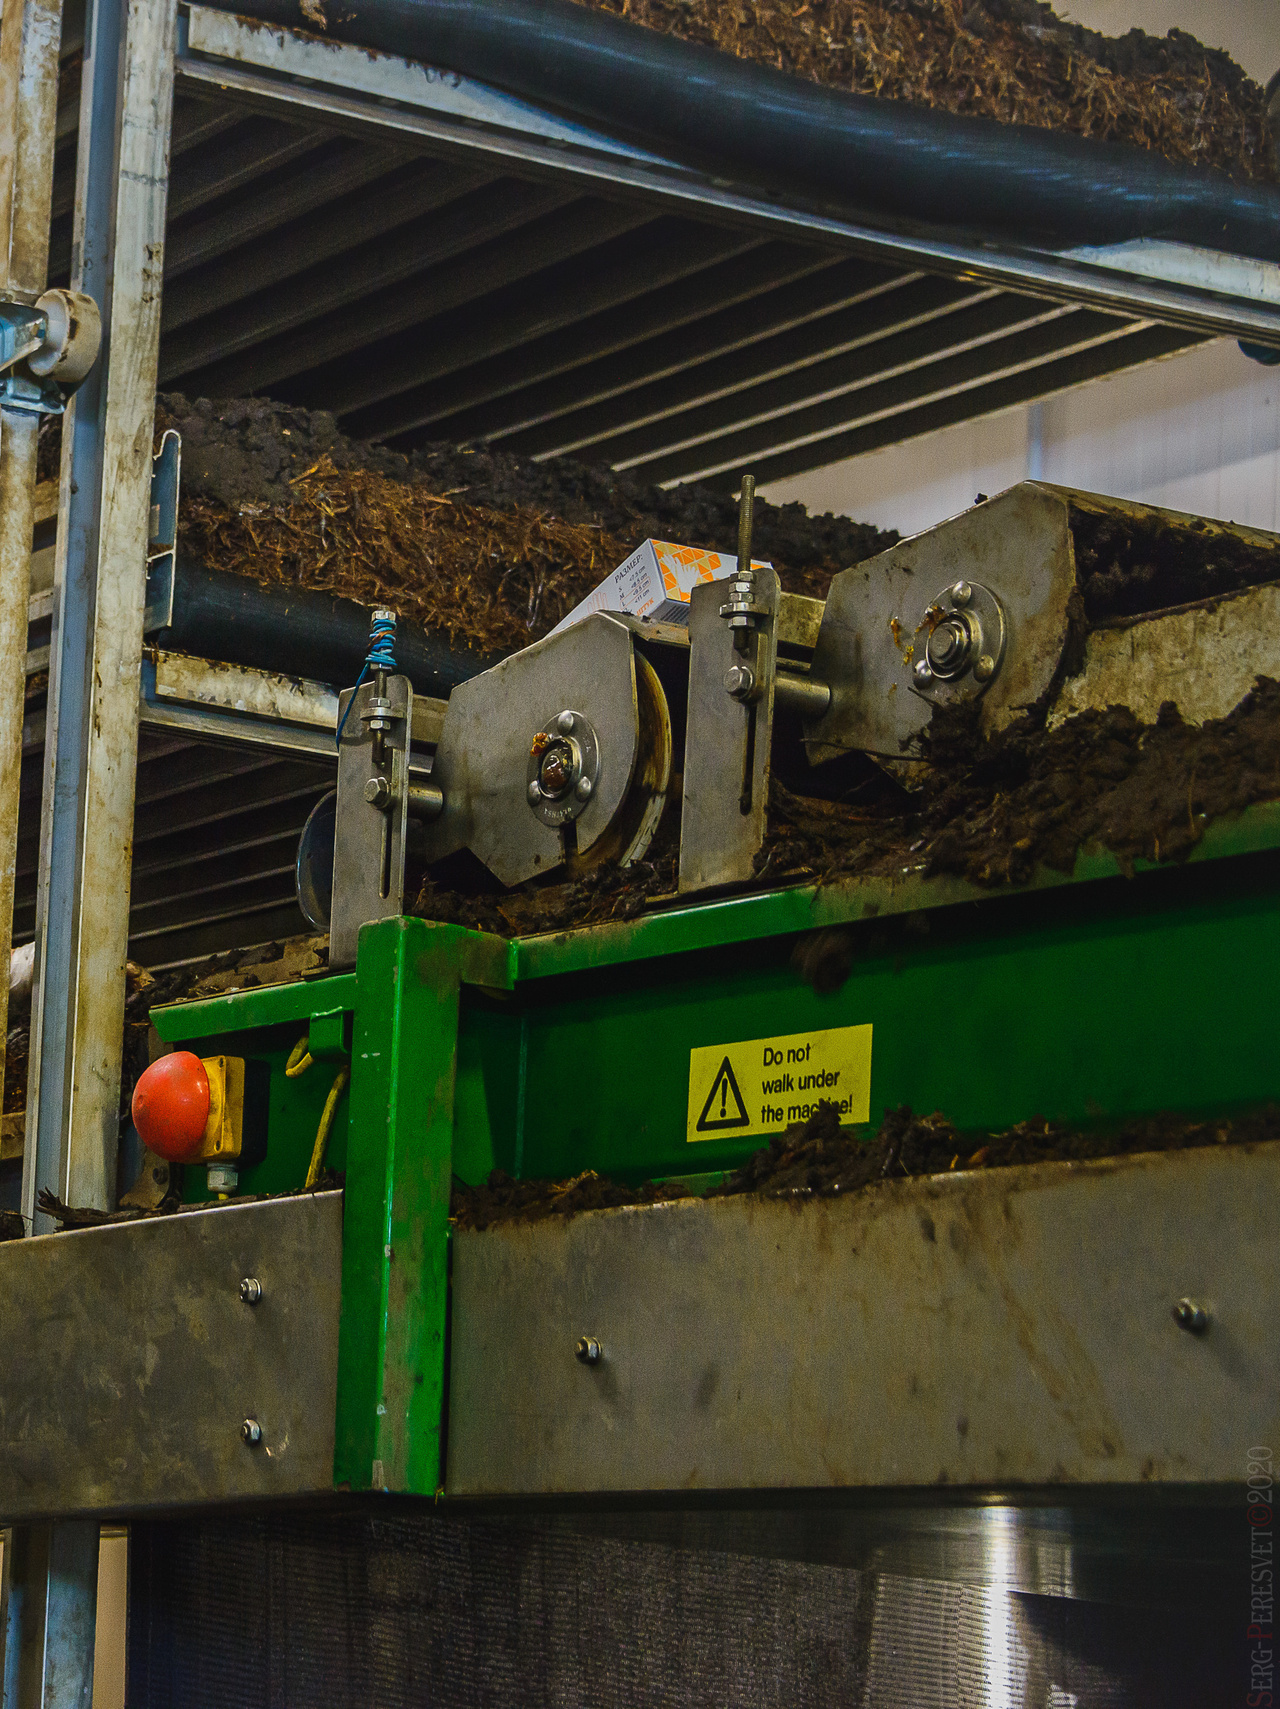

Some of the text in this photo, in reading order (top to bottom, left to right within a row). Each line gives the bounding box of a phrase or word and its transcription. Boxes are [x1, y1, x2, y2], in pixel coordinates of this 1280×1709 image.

[614, 554, 643, 584] РАЗМЕР:
[619, 592, 625, 601] M
[763, 1043, 811, 1067] Do not
[762, 1068, 840, 1095] walk under
[761, 1104, 784, 1124] the
